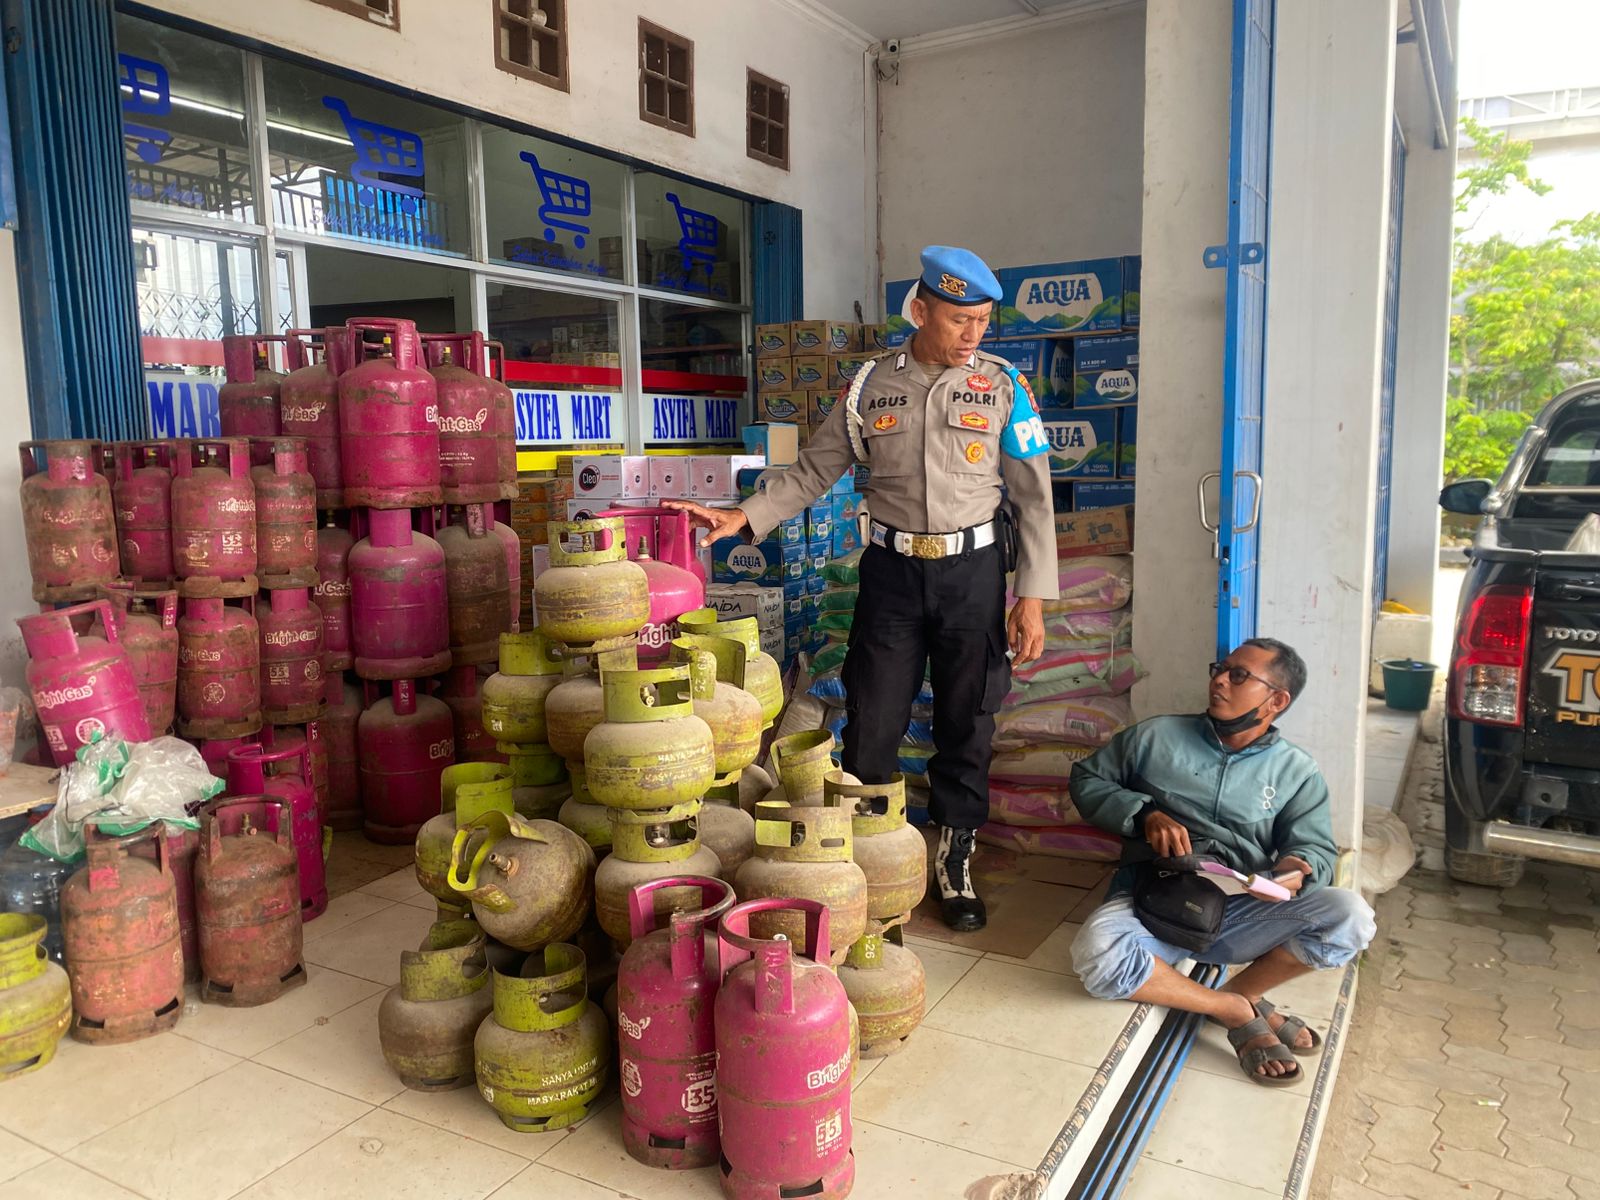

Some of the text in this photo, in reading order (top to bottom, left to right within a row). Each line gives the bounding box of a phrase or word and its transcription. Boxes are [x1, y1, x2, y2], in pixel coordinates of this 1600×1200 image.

[1027, 278, 1091, 306] AQUA
[1101, 377, 1131, 390] AQUA
[868, 395, 908, 411] AGUS
[952, 391, 996, 406] POLRI
[571, 395, 611, 439] MART
[653, 397, 738, 439] ASYIFA MART
[582, 473, 597, 485] Cleo
[732, 555, 762, 568] AQUA
[64, 685, 93, 702] Gas
[527, 1081, 588, 1105] MASYARAKAT
